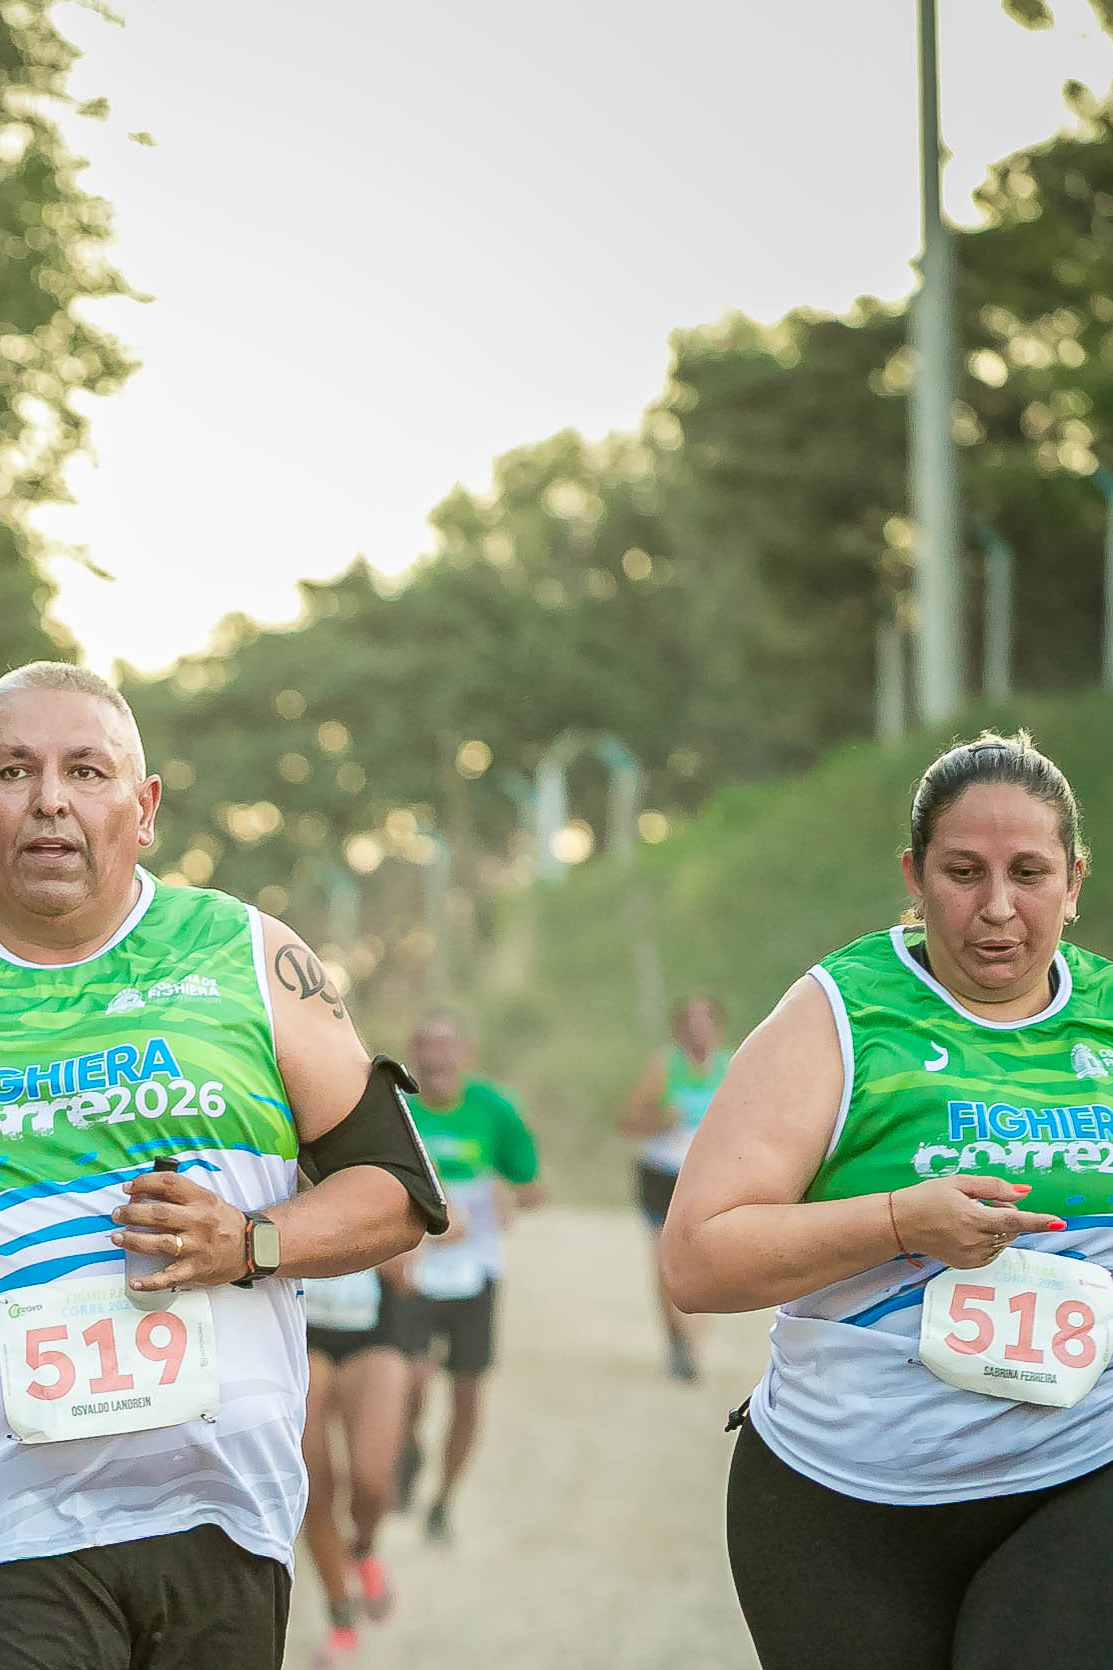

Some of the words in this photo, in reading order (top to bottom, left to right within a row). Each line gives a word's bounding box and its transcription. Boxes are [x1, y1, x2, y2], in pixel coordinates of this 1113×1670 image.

[944, 1283, 1097, 1369] 518
[26, 1311, 188, 1401] 519
[983, 1366, 1019, 1380] SABRINA
[1020, 1370, 1058, 1385] FERREIRA
[71, 1401, 109, 1417] OSVALDO
[111, 1396, 152, 1412] LANDREIN
